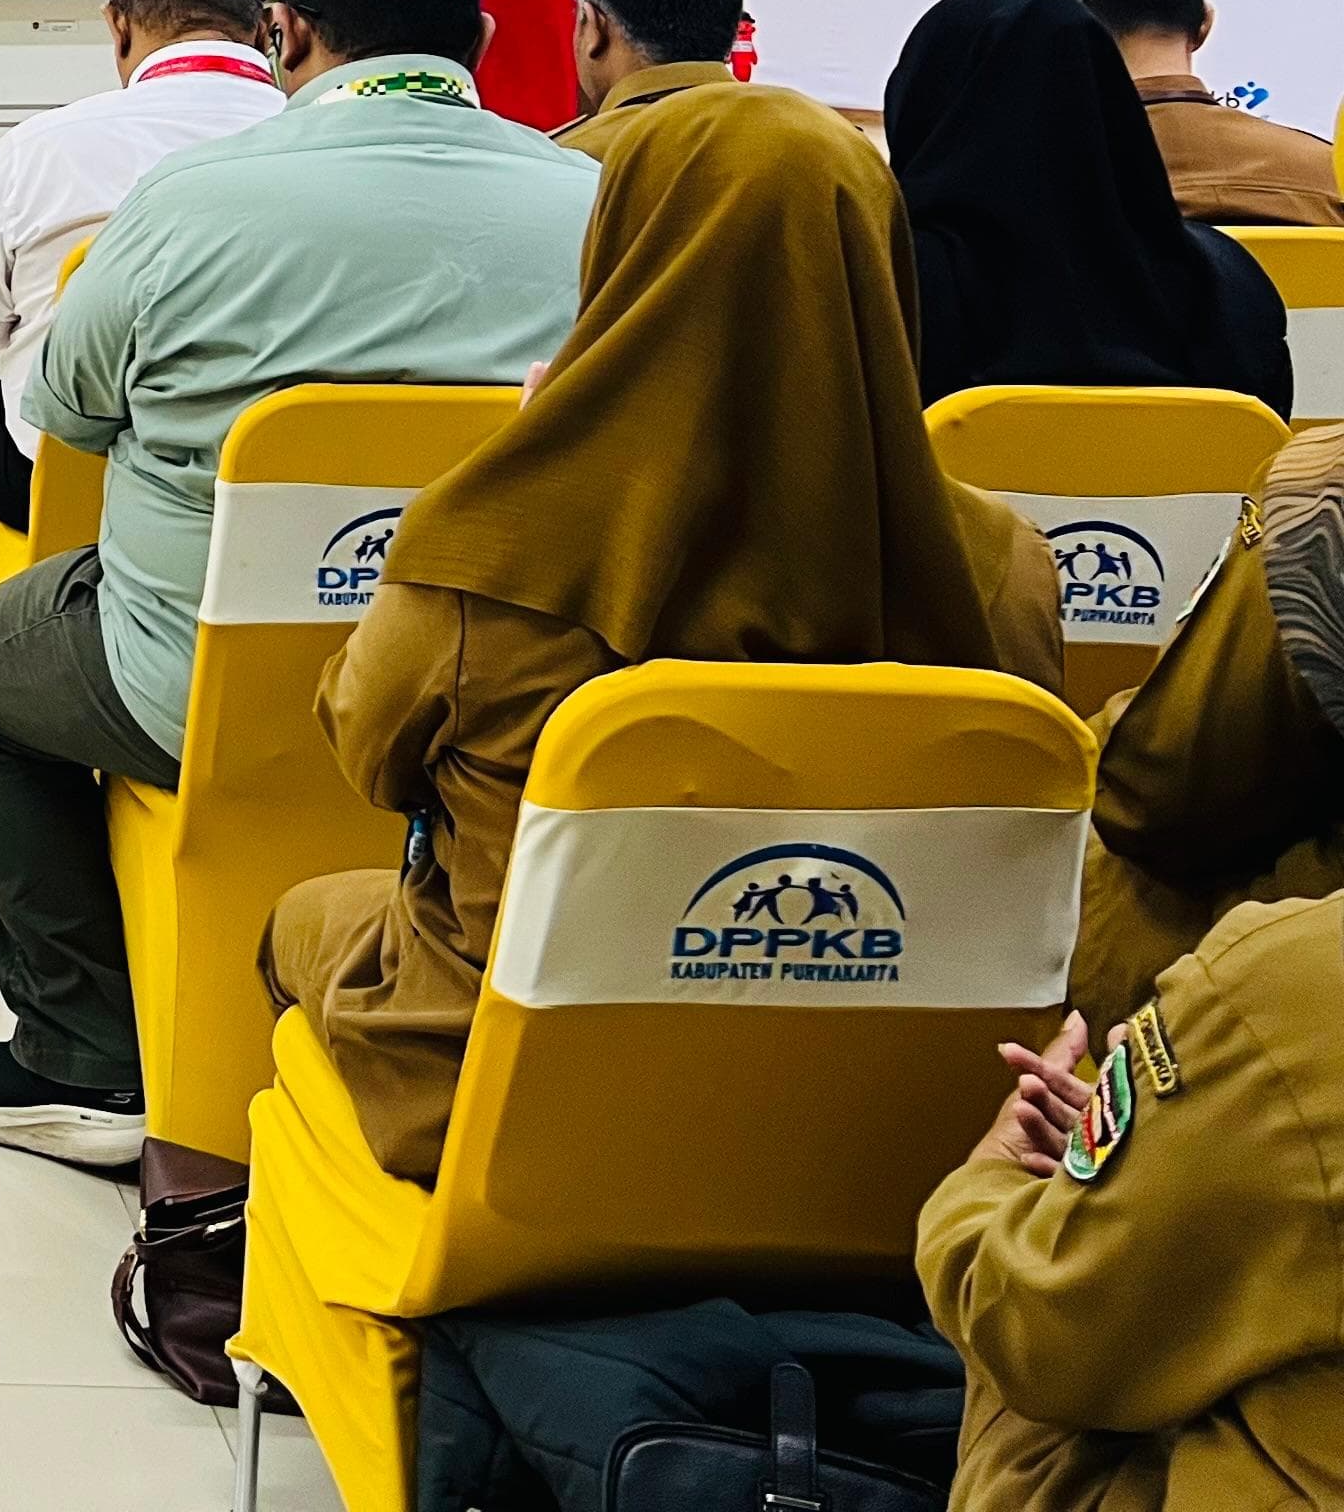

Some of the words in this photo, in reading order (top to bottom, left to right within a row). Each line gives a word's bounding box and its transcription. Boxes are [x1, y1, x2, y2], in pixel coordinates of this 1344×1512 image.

[318, 592, 375, 606] KABUPAT
[1064, 583, 1162, 609] PKB
[671, 926, 904, 960] DPPKB
[670, 961, 773, 981] KABUPATEN
[780, 962, 900, 983] PURWAKARTA
